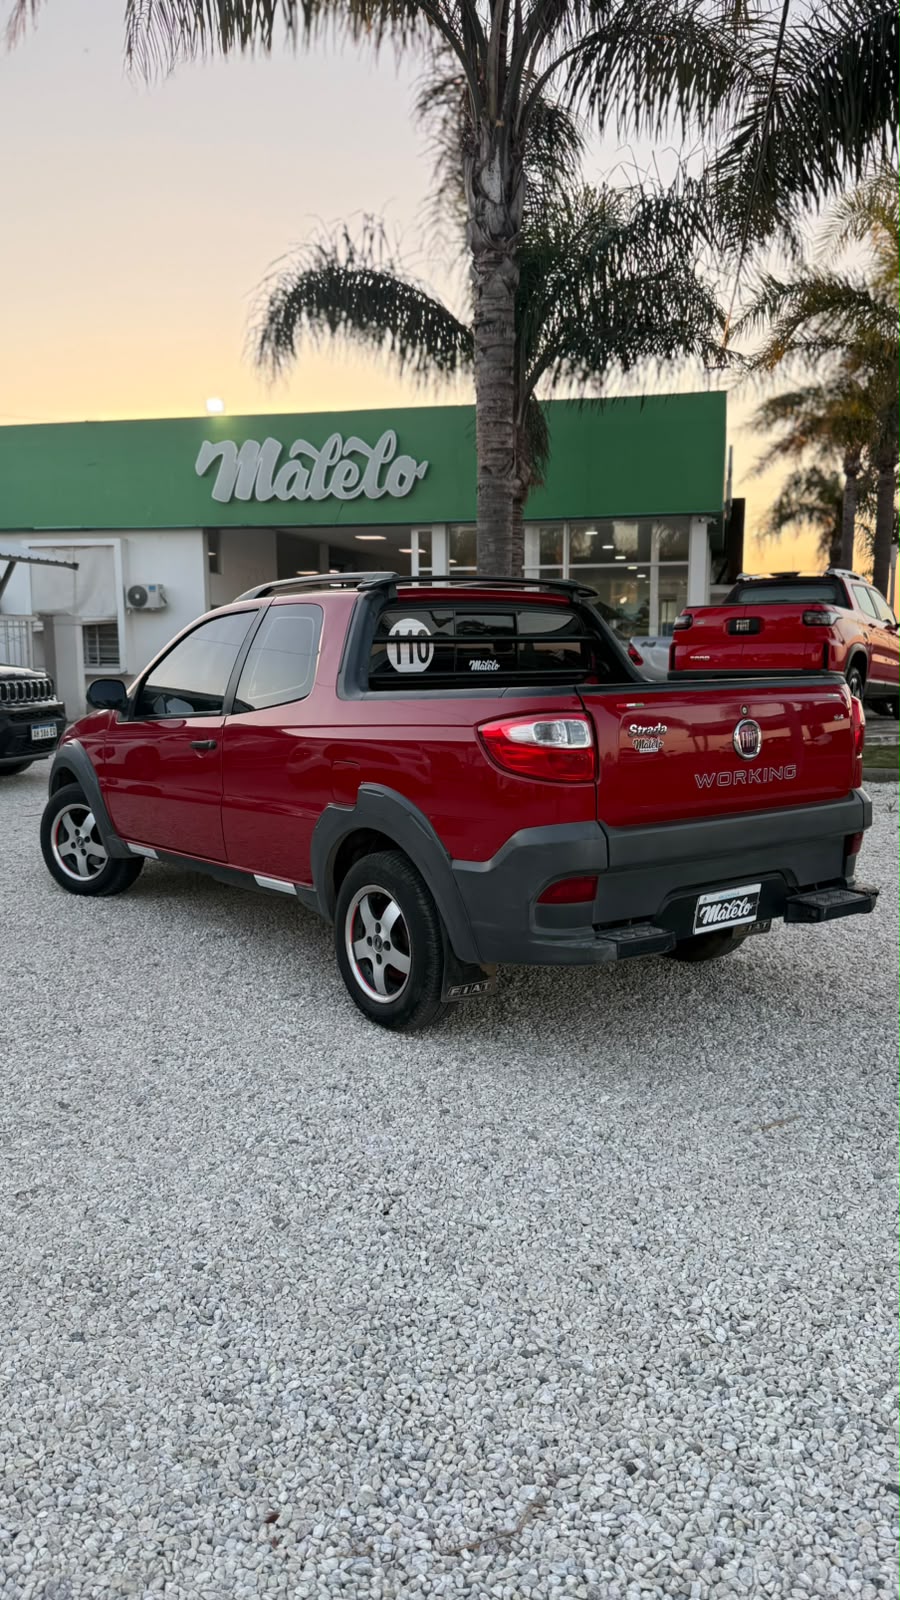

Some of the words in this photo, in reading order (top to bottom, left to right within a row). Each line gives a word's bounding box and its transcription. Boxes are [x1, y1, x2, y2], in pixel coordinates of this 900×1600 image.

[395, 629, 430, 664] 110
[628, 722, 668, 737] Strada
[694, 764, 797, 789] WORKING
[449, 982, 489, 997] FIAT
